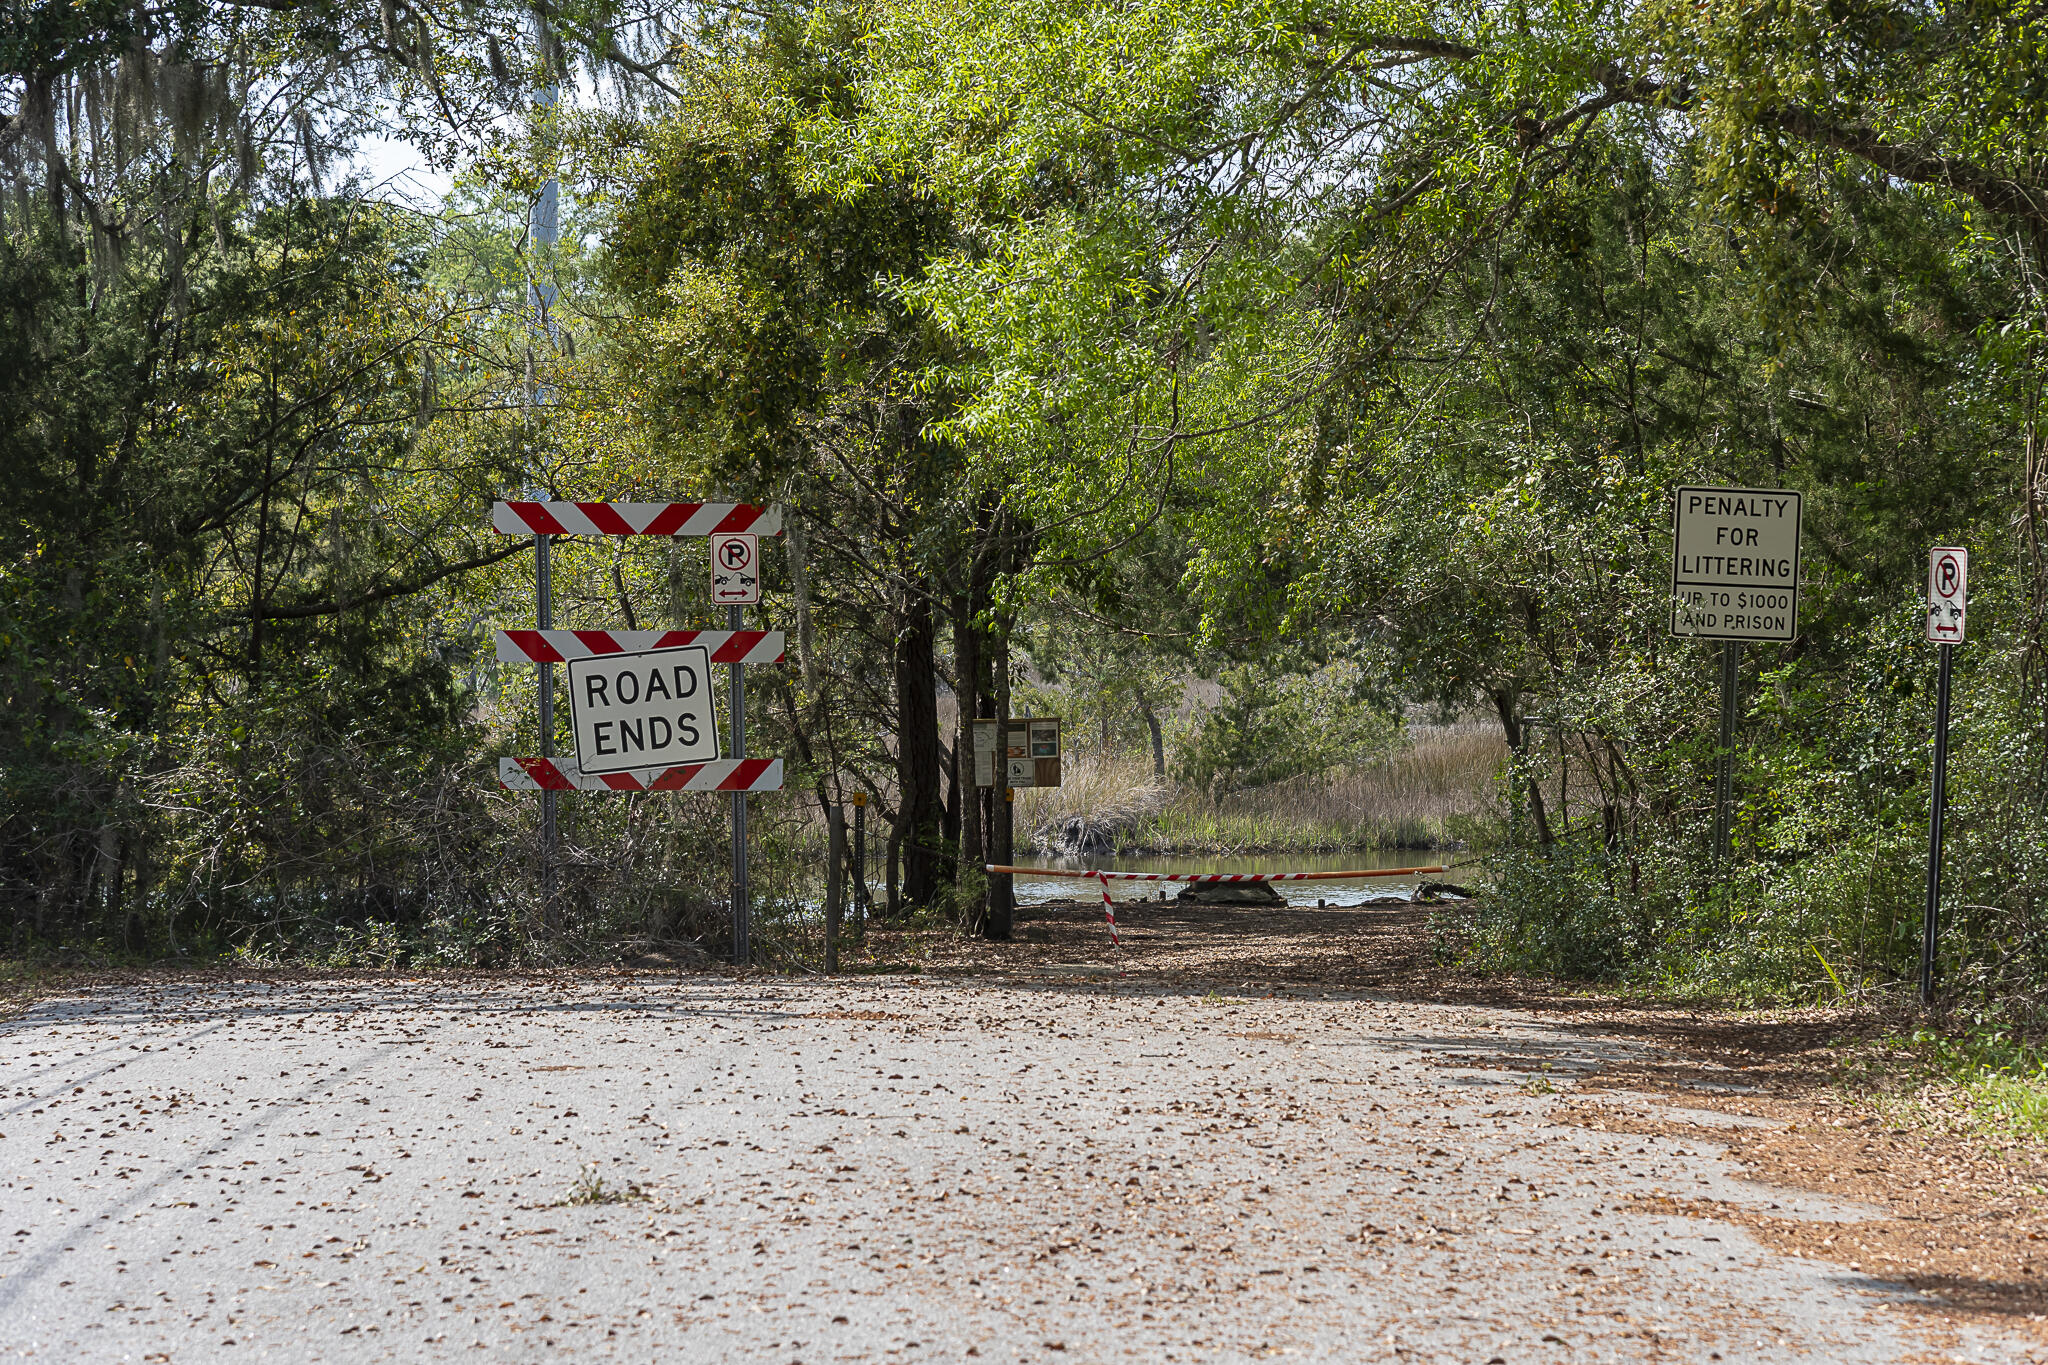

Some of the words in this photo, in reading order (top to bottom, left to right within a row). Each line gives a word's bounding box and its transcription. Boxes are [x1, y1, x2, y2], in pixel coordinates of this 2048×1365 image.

[1689, 496, 1788, 518] PENALTY
[1716, 527, 1759, 546] FOR
[1682, 555, 1790, 578] LITTERING
[1711, 592, 1730, 607] TO
[1738, 592, 1788, 610] $1000
[1682, 613, 1717, 628] AND
[1724, 614, 1785, 631] PRISON
[585, 665, 698, 708] ROAD
[593, 712, 700, 756] ENDS
